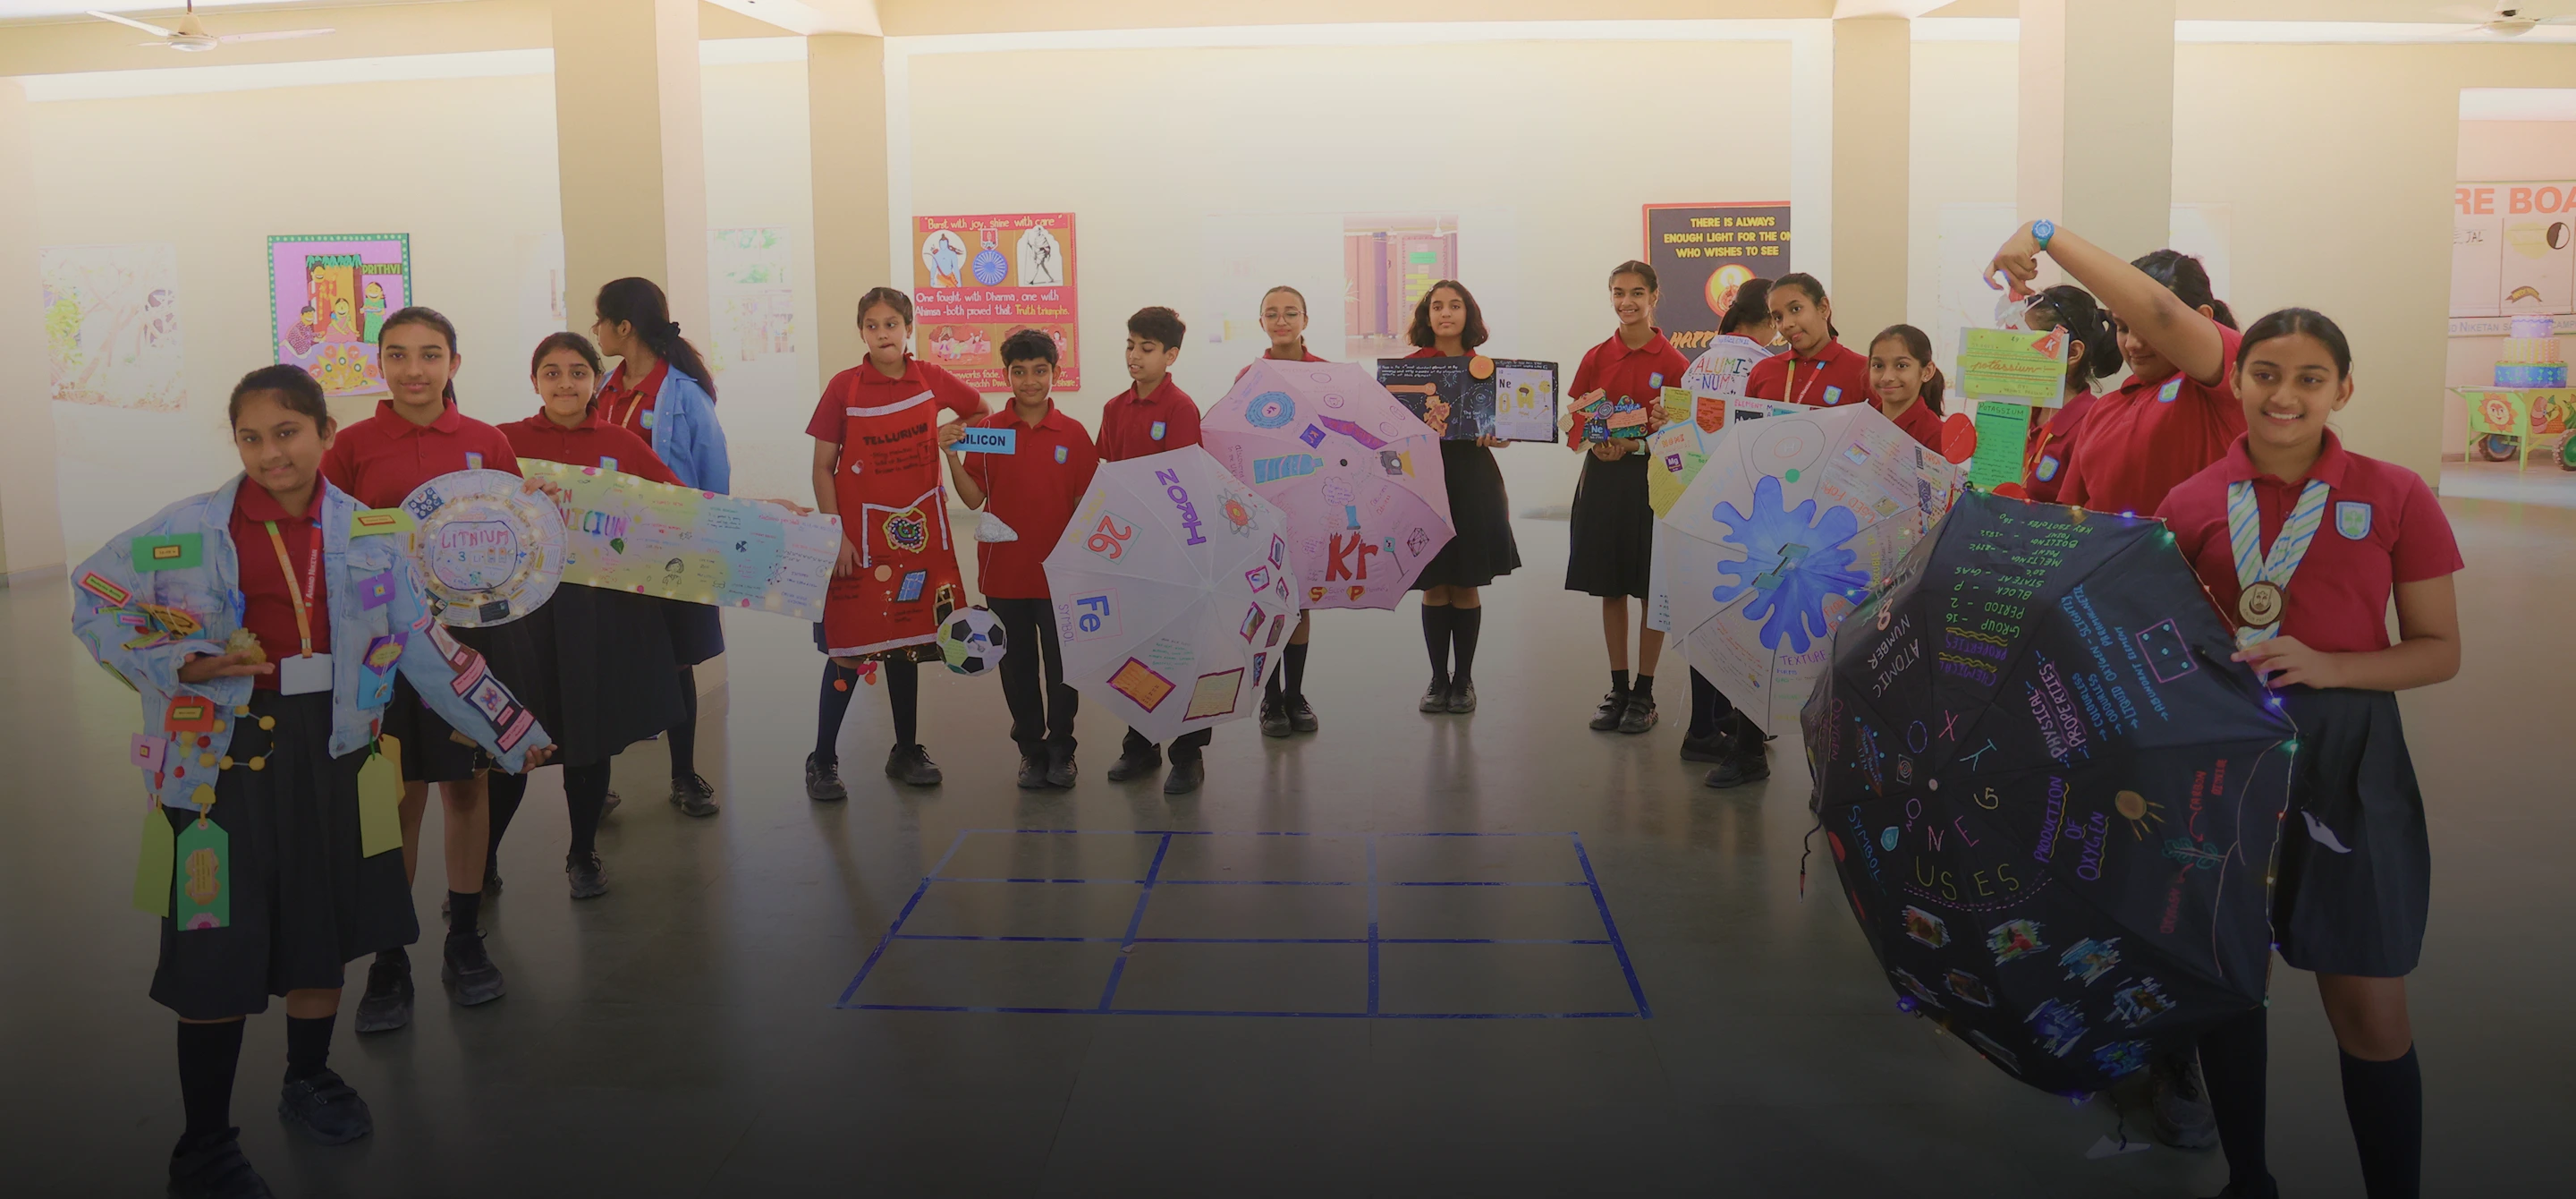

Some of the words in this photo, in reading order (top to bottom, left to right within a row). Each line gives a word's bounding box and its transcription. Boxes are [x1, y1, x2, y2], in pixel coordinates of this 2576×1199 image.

[951, 217, 968, 228] with
[970, 219, 986, 231] joy,
[990, 217, 1010, 228] shine
[1014, 216, 1032, 226] with
[1690, 217, 1720, 227] THERE
[1724, 217, 1733, 227] IS
[1736, 217, 1775, 226] ALWAYS
[1664, 233, 1703, 243] ENOUGH
[1707, 232, 1733, 242] LIGHT
[1737, 232, 1756, 242] FOR
[1758, 232, 1776, 242] THE
[1675, 248, 1700, 258] WHO
[1704, 246, 1742, 257] WISHES
[1745, 246, 1758, 256] TO
[1760, 245, 1779, 256] SEE
[361, 263, 401, 275] PRITHVI
[915, 292, 934, 302] One
[936, 291, 962, 304] fought
[964, 290, 981, 302] with
[1021, 293, 1038, 302] one
[1040, 290, 1059, 301] with
[915, 305, 941, 317] Ahimsa
[967, 305, 991, 319] proved
[995, 304, 1013, 316] that
[1015, 304, 1036, 315] Truth
[2045, 339, 2056, 351] K
[1499, 378, 1512, 388] Ne
[1734, 399, 1763, 409] ELEMENT
[862, 422, 928, 446] TELLURIUM
[1591, 425, 1603, 433] Ne
[1667, 457, 1679, 469] Mg
[1848, 497, 1876, 524] USED
[1087, 514, 1132, 560] 26
[308, 548, 318, 575] NIKETAN
[458, 551, 467, 562] 3
[1325, 531, 1379, 582] Kr
[2011, 556, 2063, 568] MELTING
[1954, 565, 1983, 577] GAS
[2016, 575, 2045, 588] STATE
[305, 576, 315, 600] ANAND
[1996, 585, 2033, 601] BLOCK
[1076, 595, 1110, 633] Fe
[1877, 598, 1894, 631] 8
[1950, 597, 1959, 608] 2
[1984, 601, 2026, 620] PERIOD
[1057, 604, 1074, 647] SYMBOL
[1945, 612, 1959, 623] 16
[1980, 618, 2021, 639] GROUP
[2060, 595, 2092, 638] SLIGHTLY
[1868, 614, 1911, 670] NUMBER
[1945, 632, 2008, 661] PROPERTIES
[1872, 638, 1920, 699] ATOMIC
[1939, 659, 1997, 687] CHEMICAL
[2089, 644, 2118, 682] OXYGEN
[2038, 662, 2087, 748] PROPERTIES
[2072, 672, 2104, 727] COLOURLESS
[2111, 685, 2138, 719] LIQUID
[2028, 688, 2068, 760] PHYSICAL
[2033, 776, 2063, 864] PRODUCTION
[2064, 816, 2082, 840] OF
[1847, 805, 1881, 881] SYMBOL
[2075, 812, 2106, 881] OXYGEN
[1915, 855, 2020, 901] USES
